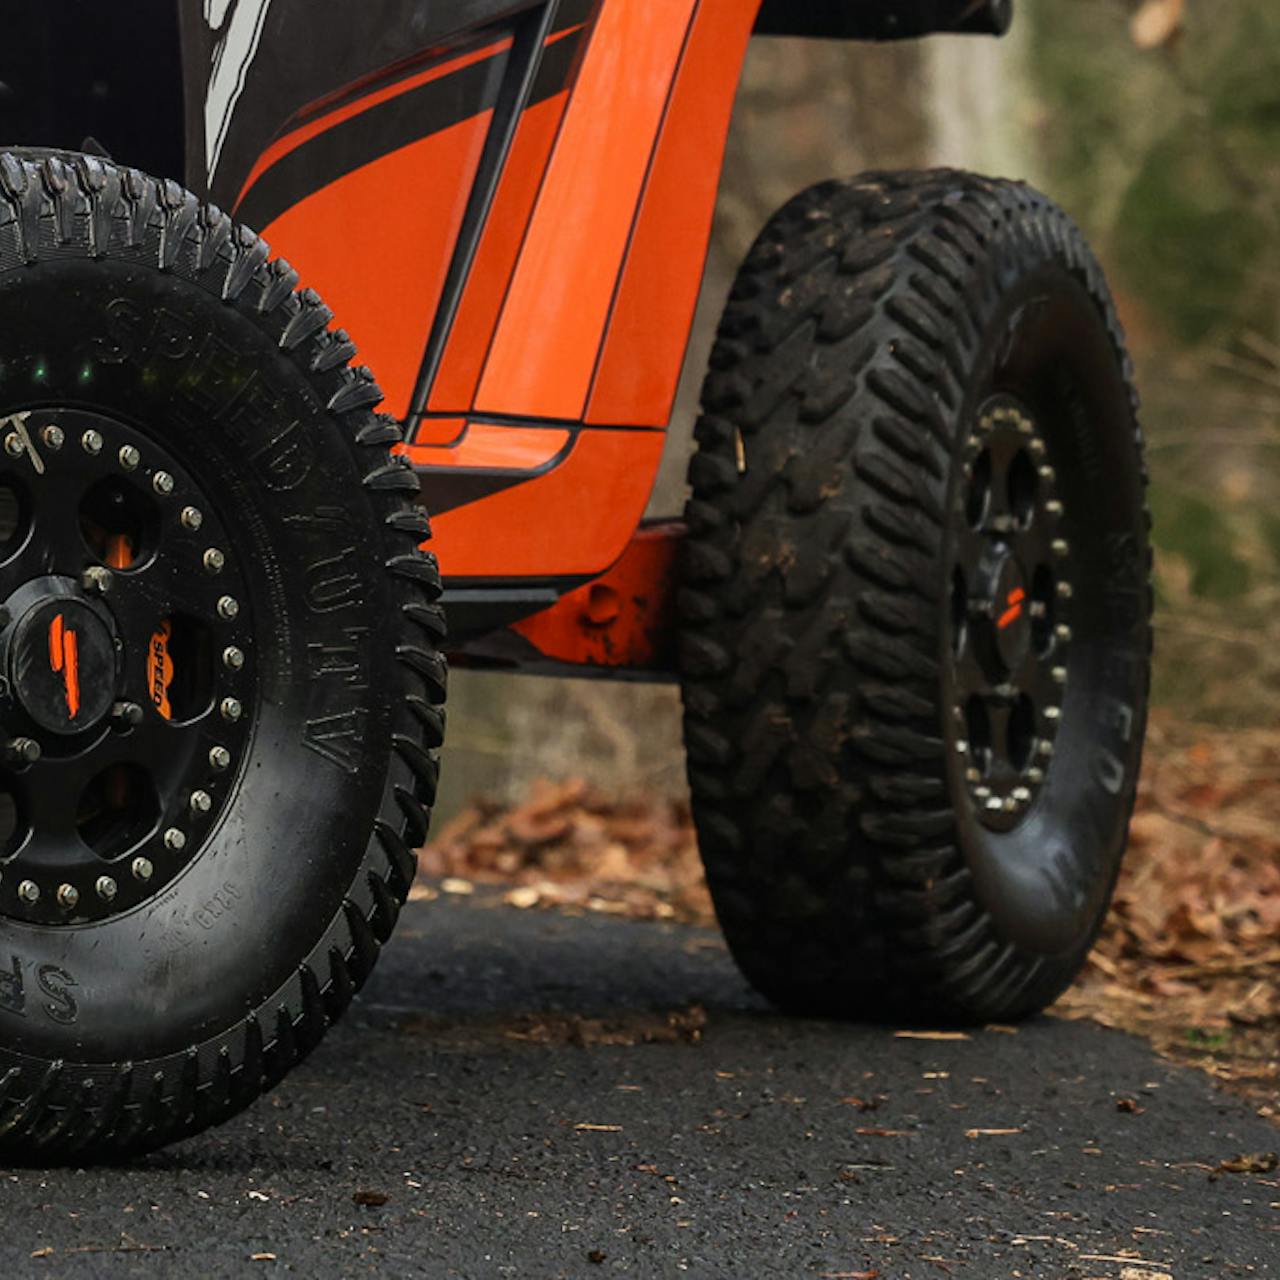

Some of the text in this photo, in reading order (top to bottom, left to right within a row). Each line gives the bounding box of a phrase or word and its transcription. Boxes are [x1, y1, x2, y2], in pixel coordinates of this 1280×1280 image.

[92, 296, 317, 493] SPEED
[301, 544, 370, 775] UTV
[153, 640, 165, 706] SPEED
